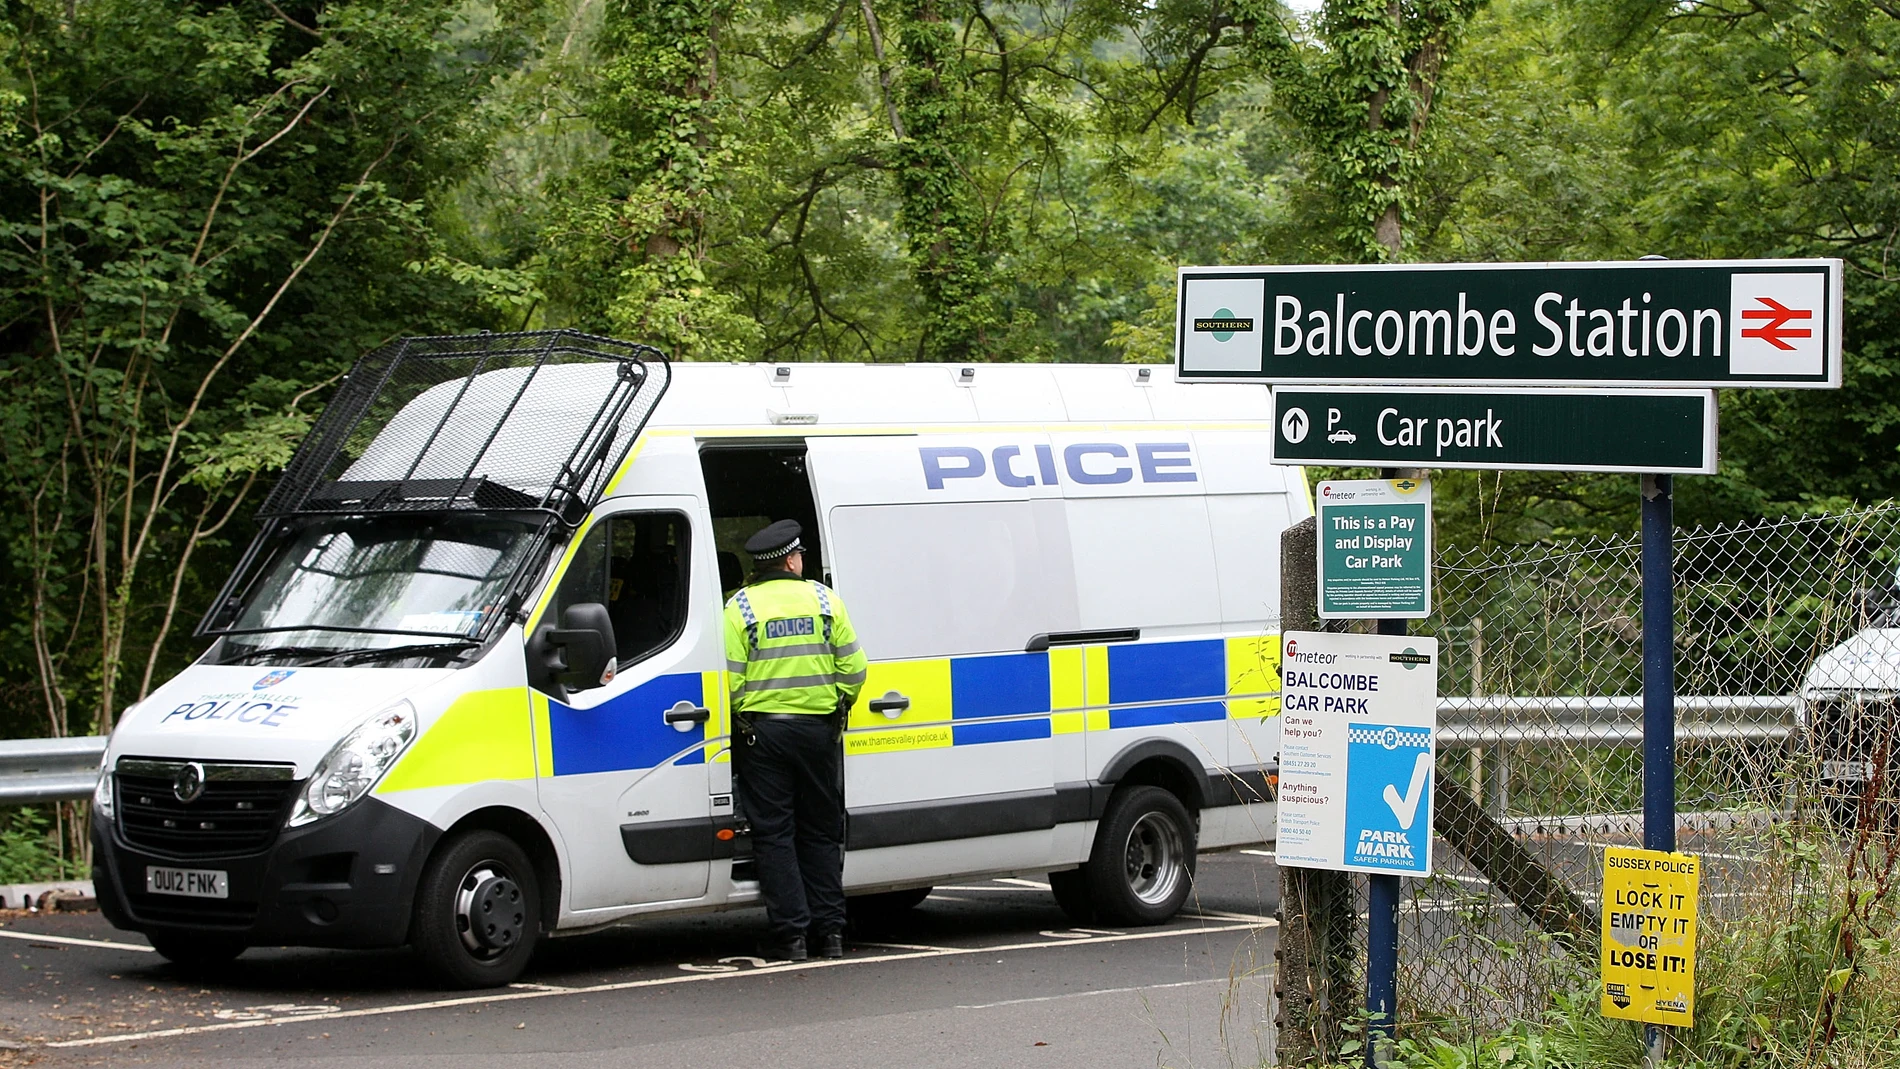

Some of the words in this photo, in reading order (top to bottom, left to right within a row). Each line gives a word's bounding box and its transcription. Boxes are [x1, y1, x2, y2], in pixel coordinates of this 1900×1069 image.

[1273, 292, 1516, 357] Balcombe
[1532, 292, 1722, 358] Station
[1377, 407, 1428, 446] Car
[1436, 408, 1503, 457] park
[1330, 492, 1356, 500] meteor
[1332, 516, 1360, 530] This
[1364, 516, 1375, 530] is
[1378, 519, 1386, 529] a
[1390, 516, 1415, 532] Pay
[1335, 536, 1360, 549] and
[1364, 535, 1412, 552] Display
[1345, 555, 1368, 568] Car
[1372, 554, 1402, 568] Park
[767, 618, 813, 638] POLICE
[1295, 651, 1338, 665] meteor
[1286, 671, 1379, 692] BALCOMBE
[252, 693, 302, 703] VALLEY
[1285, 694, 1319, 712] CAR
[1324, 696, 1369, 714] PARK
[160, 701, 299, 727] POLICE
[1285, 716, 1300, 725] Can
[849, 732, 948, 748] www.thamesvalley.police.uk
[1284, 728, 1300, 737] help
[1303, 729, 1322, 738] you?
[1282, 782, 1318, 794] Anything
[1282, 795, 1329, 805] suspicious?
[1359, 829, 1410, 844] PARK
[1356, 842, 1414, 859] MARK
[1354, 856, 1379, 864] SAFER
[1380, 858, 1415, 866] PARKING
[1609, 857, 1651, 871] SUSSEX
[1654, 860, 1694, 874] POLICE
[154, 870, 184, 892] OU12
[188, 872, 217, 894] FNK
[1616, 889, 1663, 908] LOCK
[1670, 894, 1685, 910] IT
[1610, 912, 1668, 932] EMPTY
[1673, 918, 1689, 935] IT
[1638, 934, 1658, 950] OR
[1610, 950, 1656, 970] LOSE
[1662, 956, 1686, 973] IT!
[1607, 984, 1624, 992] CRIME
